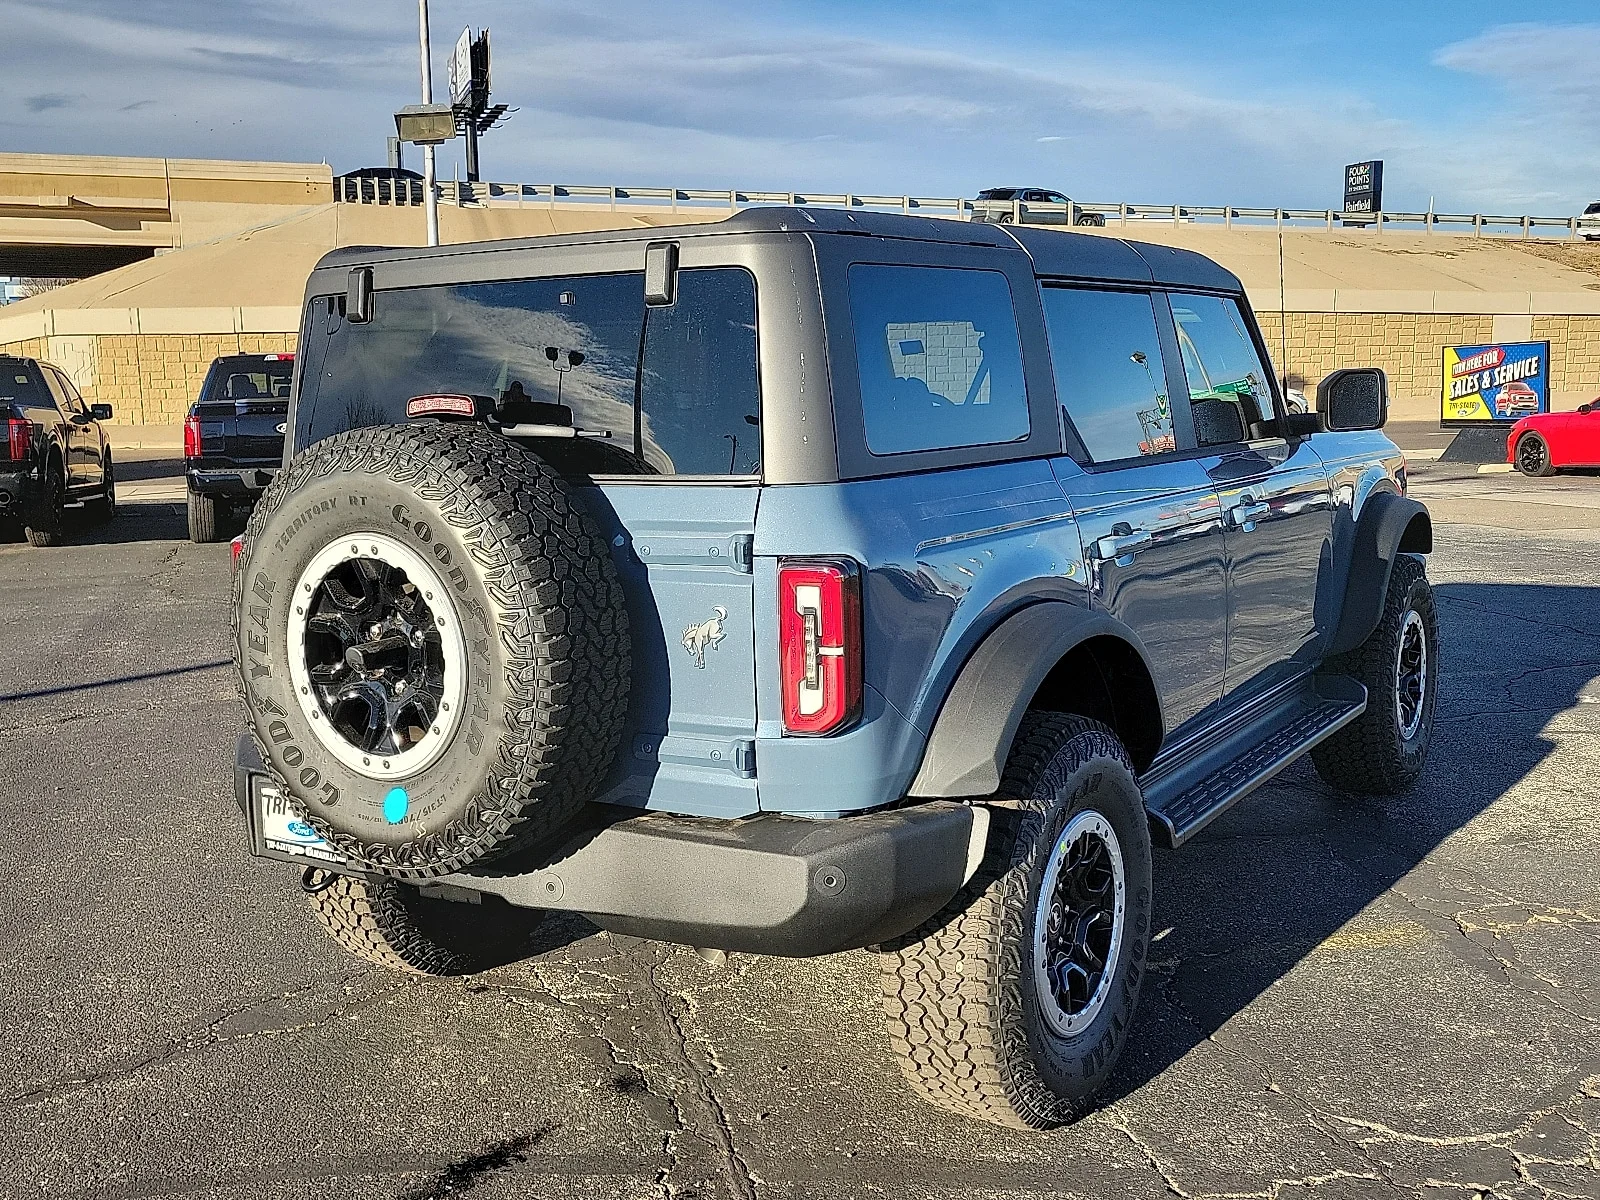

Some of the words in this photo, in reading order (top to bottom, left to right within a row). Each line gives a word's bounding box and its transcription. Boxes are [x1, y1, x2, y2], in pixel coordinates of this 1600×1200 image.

[1349, 166, 1366, 176] FOUR
[1349, 174, 1369, 186] POINTS
[1345, 199, 1370, 212] Fairfield
[1466, 356, 1483, 371] HERE
[1483, 350, 1498, 366] FOR
[1449, 374, 1480, 400] SALES
[1482, 369, 1491, 389] &
[1493, 355, 1540, 386] SERVICE
[275, 497, 337, 552] TERRITORY
[348, 495, 367, 506] RT
